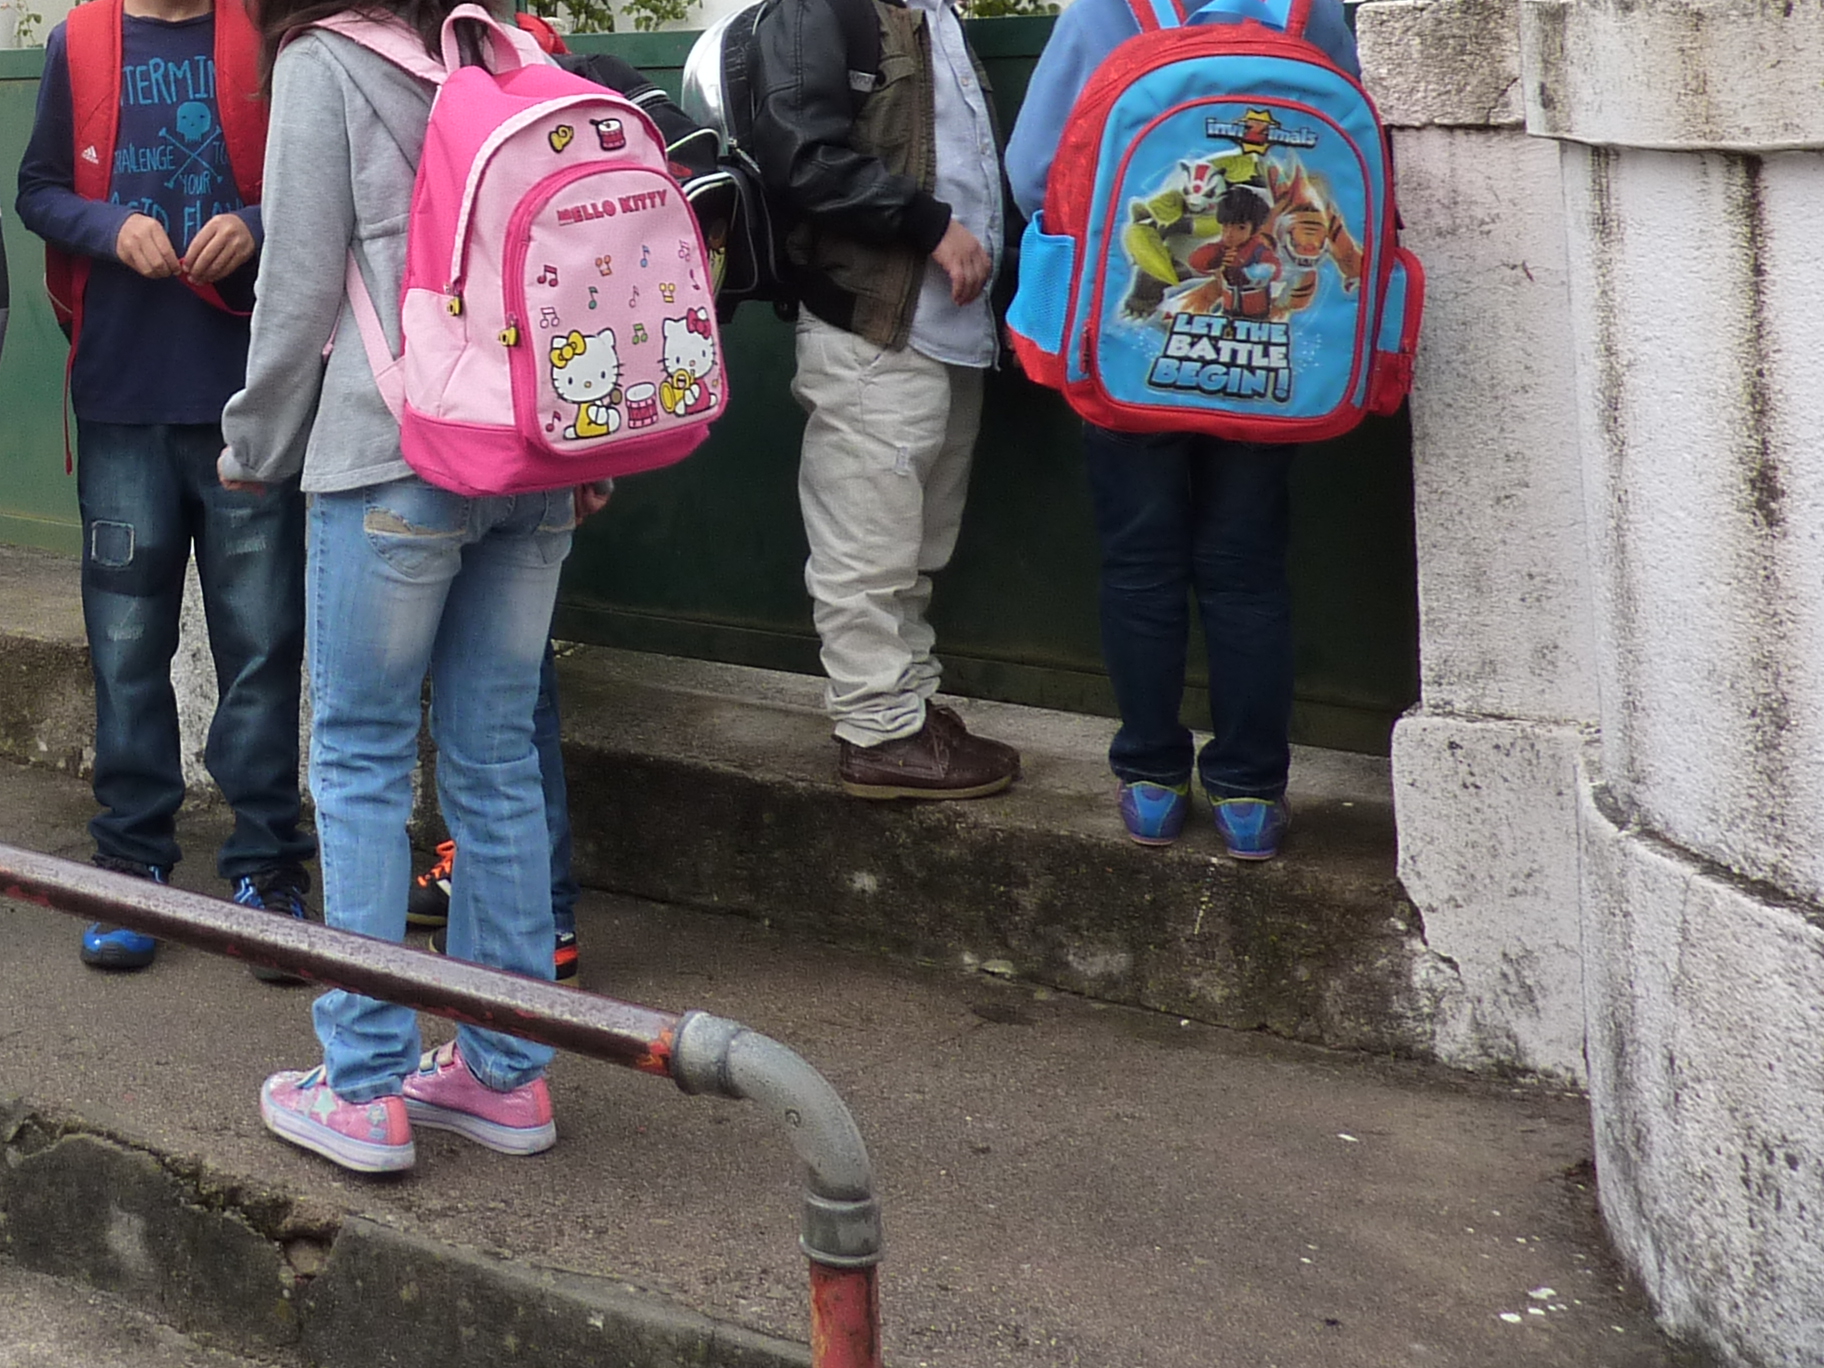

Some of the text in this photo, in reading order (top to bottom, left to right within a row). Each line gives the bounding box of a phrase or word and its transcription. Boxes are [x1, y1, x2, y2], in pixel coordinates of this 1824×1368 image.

[557, 189, 667, 226] HELLO KITTY
[1173, 314, 1288, 343] LET THE
[1166, 334, 1288, 368] BATTLE
